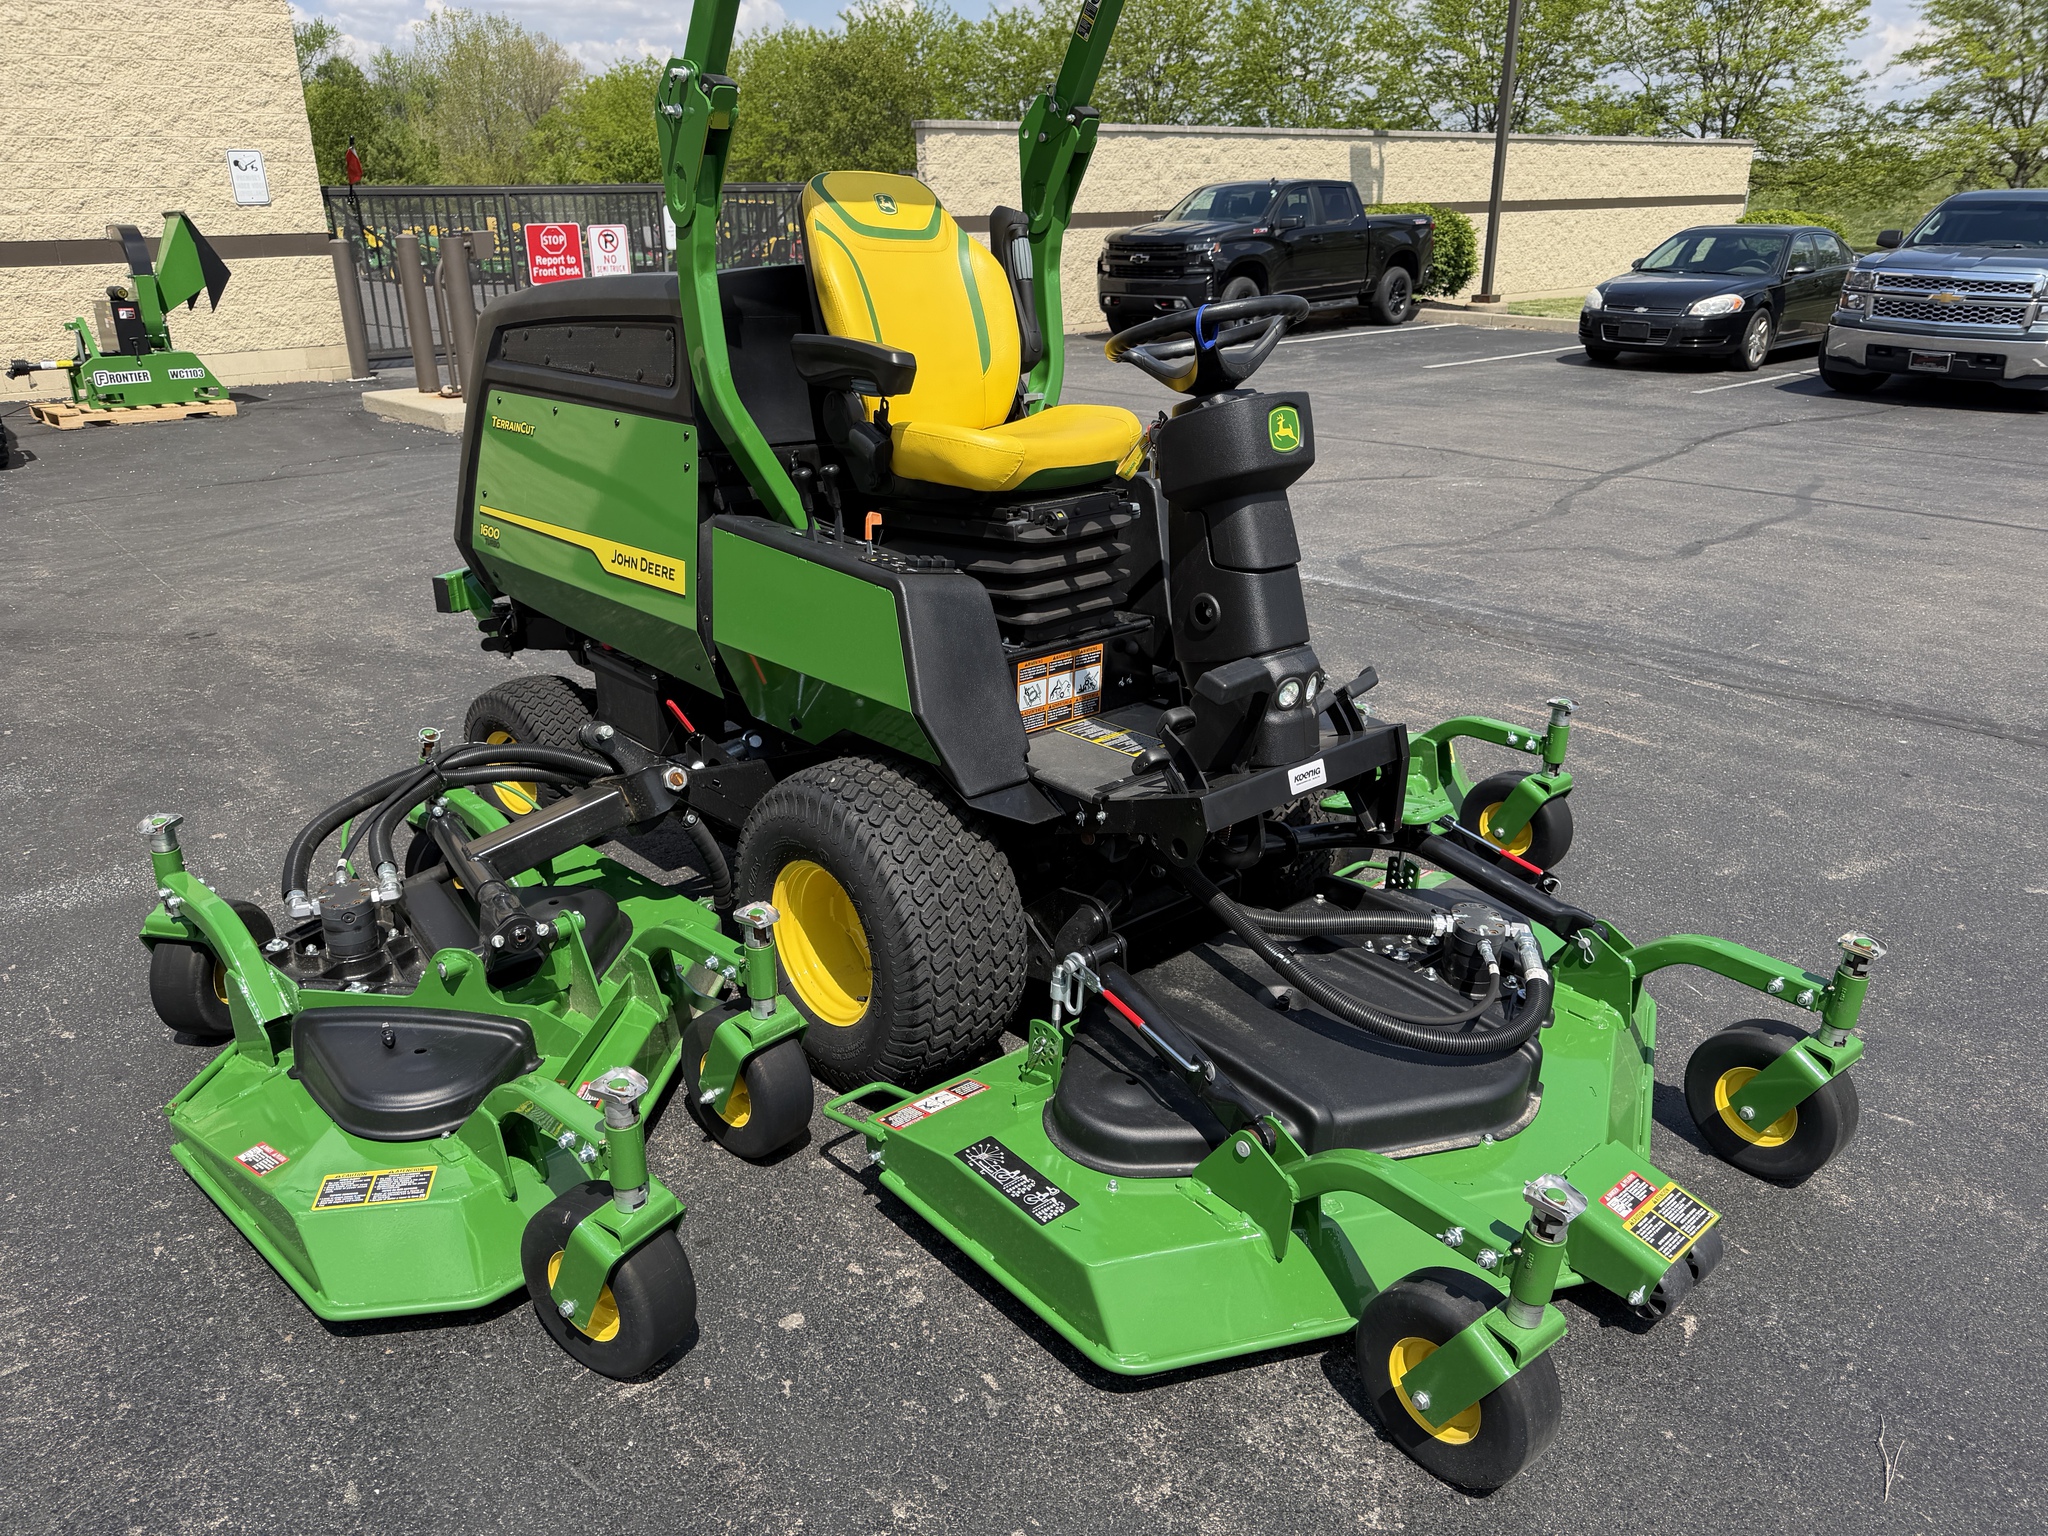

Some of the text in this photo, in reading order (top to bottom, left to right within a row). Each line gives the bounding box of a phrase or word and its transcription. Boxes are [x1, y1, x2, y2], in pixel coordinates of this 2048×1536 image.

[543, 235, 564, 246] STOP
[536, 255, 576, 266] Report to
[603, 254, 617, 264] NO
[533, 265, 581, 277] Front Desk
[95, 371, 150, 385] FRONTIER
[169, 368, 204, 379] WC1103
[480, 523, 500, 540] 1600
[611, 549, 675, 581] JOHN DEERE
